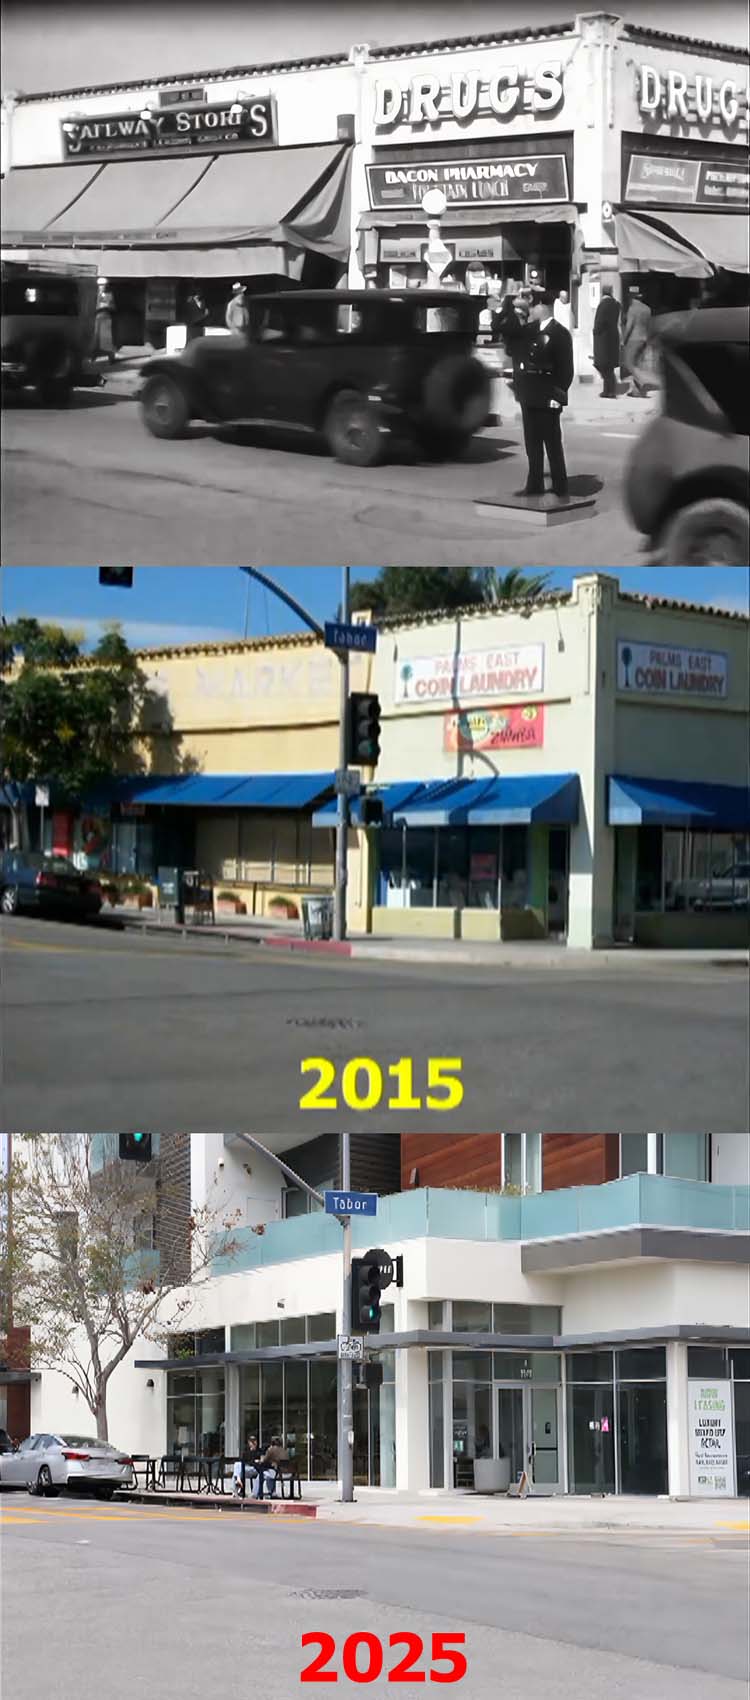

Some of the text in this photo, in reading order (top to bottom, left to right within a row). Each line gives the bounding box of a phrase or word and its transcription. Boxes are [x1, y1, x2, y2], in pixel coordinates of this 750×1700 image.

[373, 60, 563, 125] DRUGS
[385, 163, 538, 184] BACON PHARMACY
[333, 628, 368, 645] Tabor
[486, 651, 521, 668] EAST
[649, 649, 712, 672] PALMS EAST
[414, 666, 537, 697] COIN LAUNDRY
[635, 667, 725, 697] COIN LAUNDRY
[333, 1197, 368, 1211] Tabor
